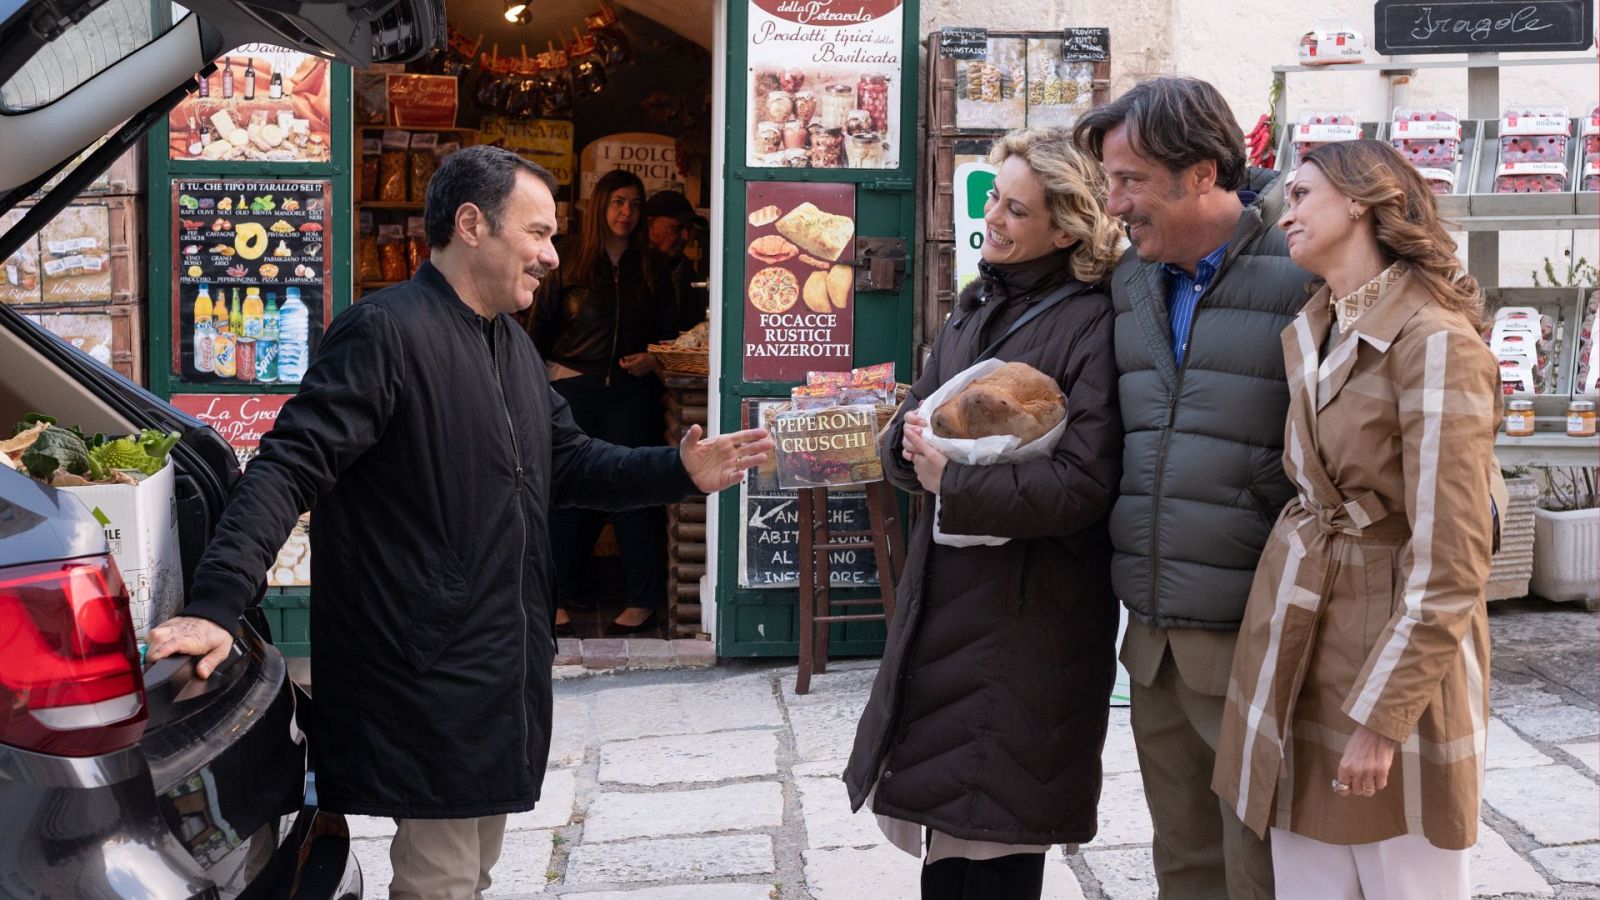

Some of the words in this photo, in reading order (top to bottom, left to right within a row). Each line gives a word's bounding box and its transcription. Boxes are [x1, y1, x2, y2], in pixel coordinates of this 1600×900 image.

[753, 20, 828, 45] Prodotti
[834, 29, 874, 47] tipici
[812, 42, 898, 63] Basilicata
[620, 146, 676, 163] DOLC
[224, 183, 245, 191] TIPO
[247, 183, 257, 191] DI
[259, 183, 299, 191] TARALLO
[300, 184, 314, 192] SEI
[759, 314, 837, 328] FOCACCE
[764, 329, 831, 343] RUSTICI
[745, 343, 850, 358] PANZEROTTI
[255, 343, 278, 377] Sprite
[196, 398, 231, 419] La
[240, 397, 283, 426] Grot
[776, 412, 871, 434] PEPERONI
[781, 432, 867, 453] CRUSCHI
[775, 510, 854, 523] ANHE
[771, 551, 793, 564] AL
